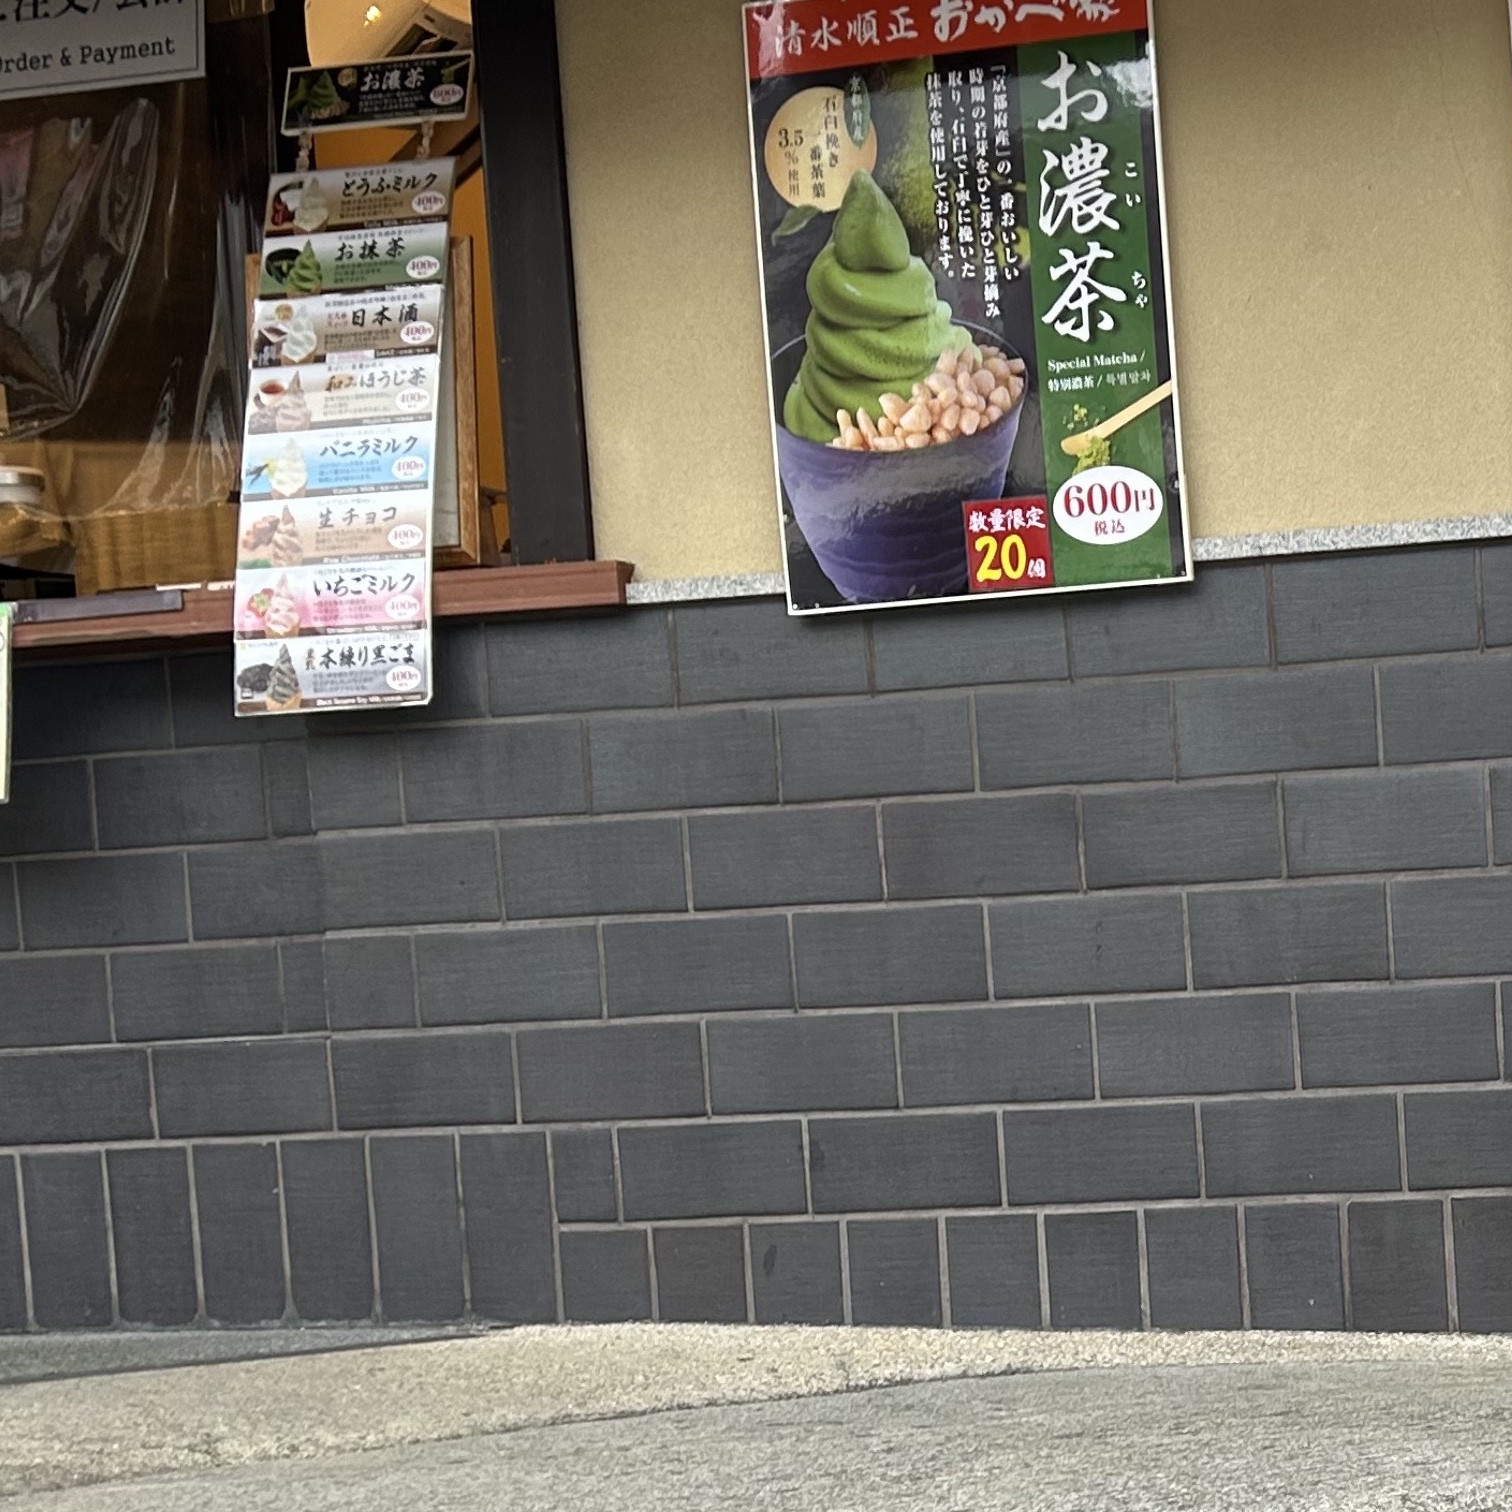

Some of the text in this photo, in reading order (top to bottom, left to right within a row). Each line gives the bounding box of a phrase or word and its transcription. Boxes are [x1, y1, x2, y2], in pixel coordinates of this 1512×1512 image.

[775, 6, 920, 58] 清水順正
[60, 47, 72, 67] &
[80, 36, 176, 65] Payment
[1037, 49, 1128, 343] お濃茶
[334, 236, 406, 262] お抹茶
[352, 302, 419, 328] 日本酒
[1047, 355, 1091, 374] Special
[1093, 351, 1138, 367] Matcha
[1063, 480, 1156, 518] 600円
[318, 505, 398, 530] 生チョコ
[968, 505, 1046, 533] 数量限定
[1094, 518, 1126, 537] 税込
[313, 572, 416, 597] いちごミルク
[320, 642, 415, 670] 本練り黒ごま
